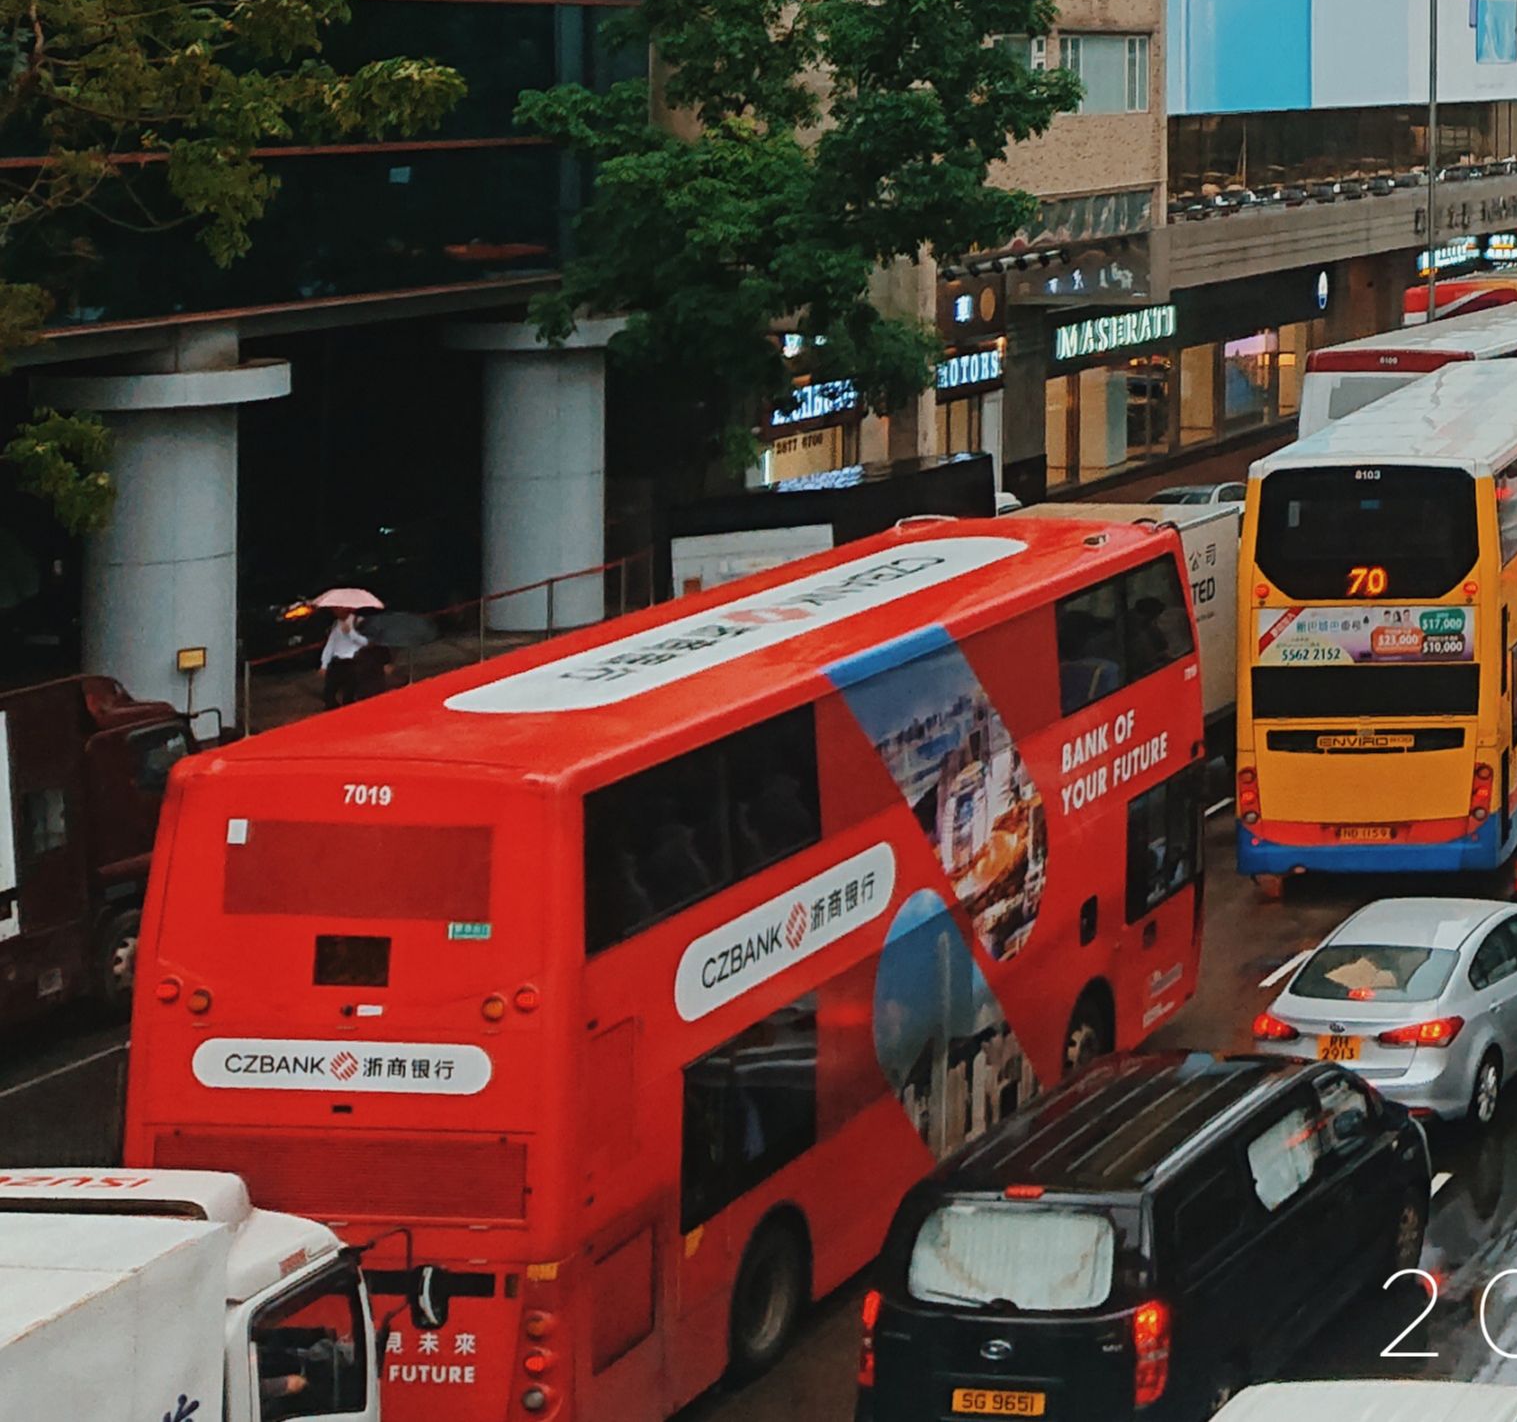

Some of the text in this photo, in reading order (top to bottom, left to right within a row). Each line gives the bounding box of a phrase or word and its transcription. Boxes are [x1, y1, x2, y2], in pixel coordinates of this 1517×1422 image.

[1056, 305, 1177, 361] MASERATI
[1189, 543, 1217, 572] 公司
[1347, 567, 1389, 597] 70
[1422, 618, 1463, 631] $17,000
[1312, 647, 1341, 660] 2152
[1422, 641, 1463, 654] $10,000
[1061, 708, 1136, 775] BANK OF
[1060, 730, 1169, 816] YOUR FUTURE
[342, 783, 393, 807] 7019
[808, 870, 877, 934] 浙商银行
[700, 919, 785, 991] CZBANK
[224, 1052, 326, 1075] CZBANK
[1321, 1047, 1355, 1060] 2913
[362, 1057, 455, 1080] 浙商银行
[0, 1176, 152, 1190] ISUZ
[388, 1364, 476, 1384] FUTURE
[961, 1392, 1036, 1412] SG 9651
